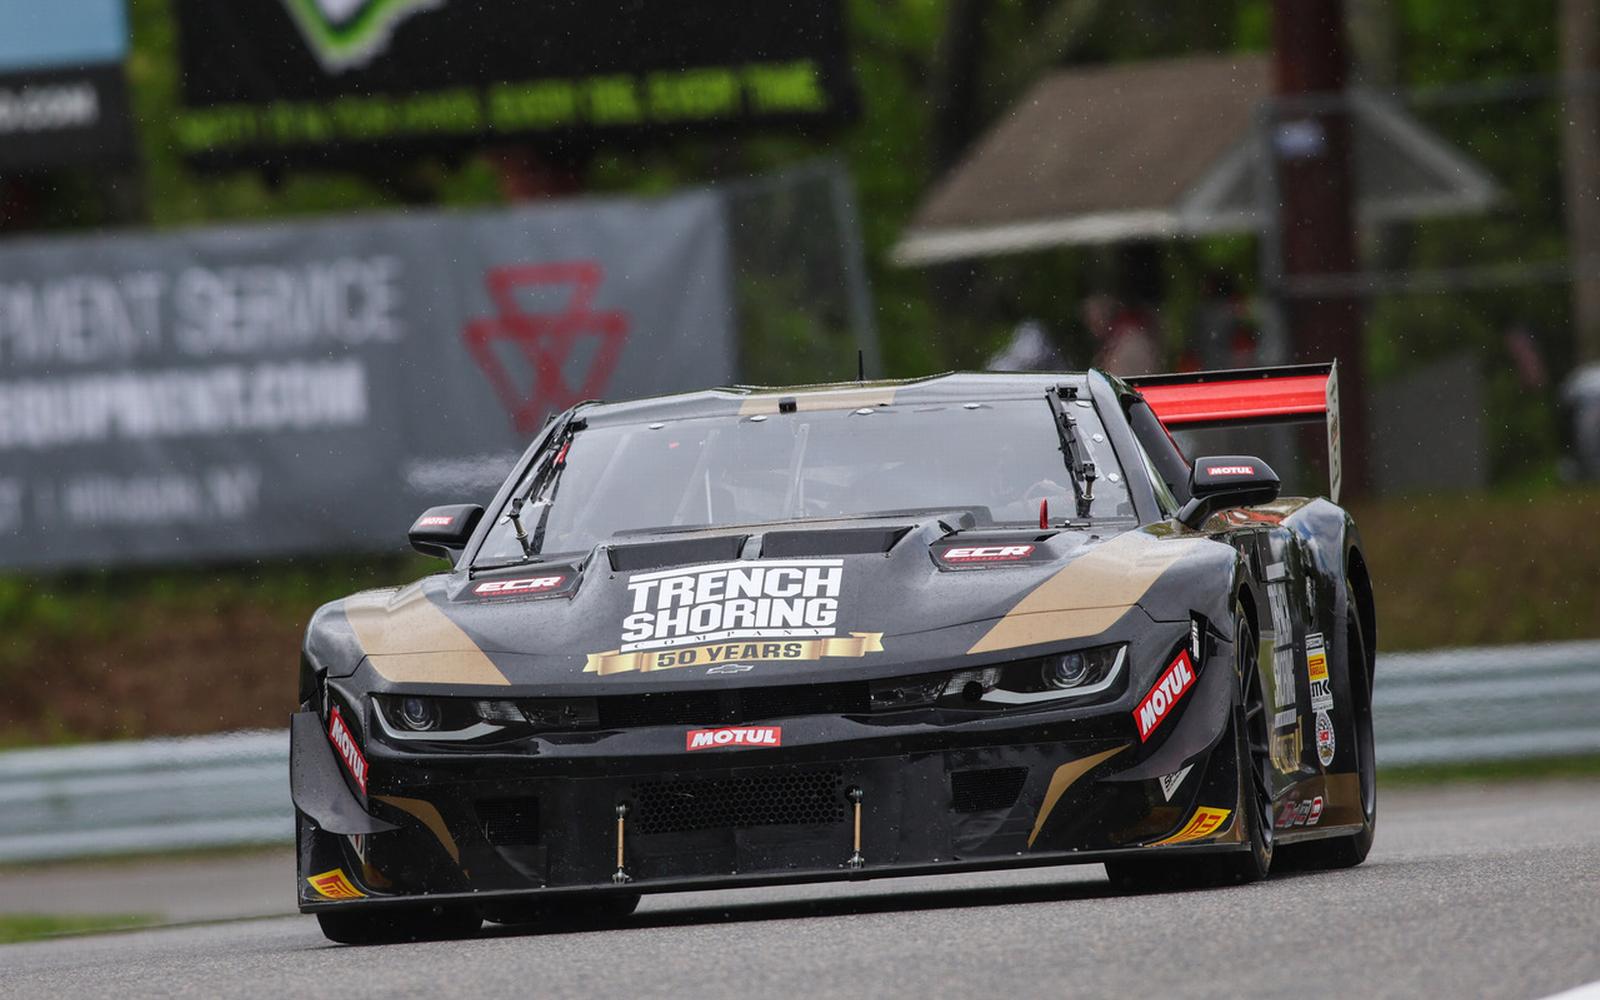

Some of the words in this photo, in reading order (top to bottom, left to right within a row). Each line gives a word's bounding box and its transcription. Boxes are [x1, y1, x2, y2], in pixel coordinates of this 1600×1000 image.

[1211, 465, 1252, 475] MOTUL
[945, 546, 1031, 558] ECR
[475, 577, 561, 592] ECR
[628, 567, 843, 613] TRENCH
[621, 598, 838, 642] SHORING
[657, 650, 696, 667] 50
[706, 643, 802, 663] YEARS
[1140, 659, 1191, 735] MOTUL
[691, 729, 776, 747] MOTUL
[331, 716, 365, 785] MOTUL
